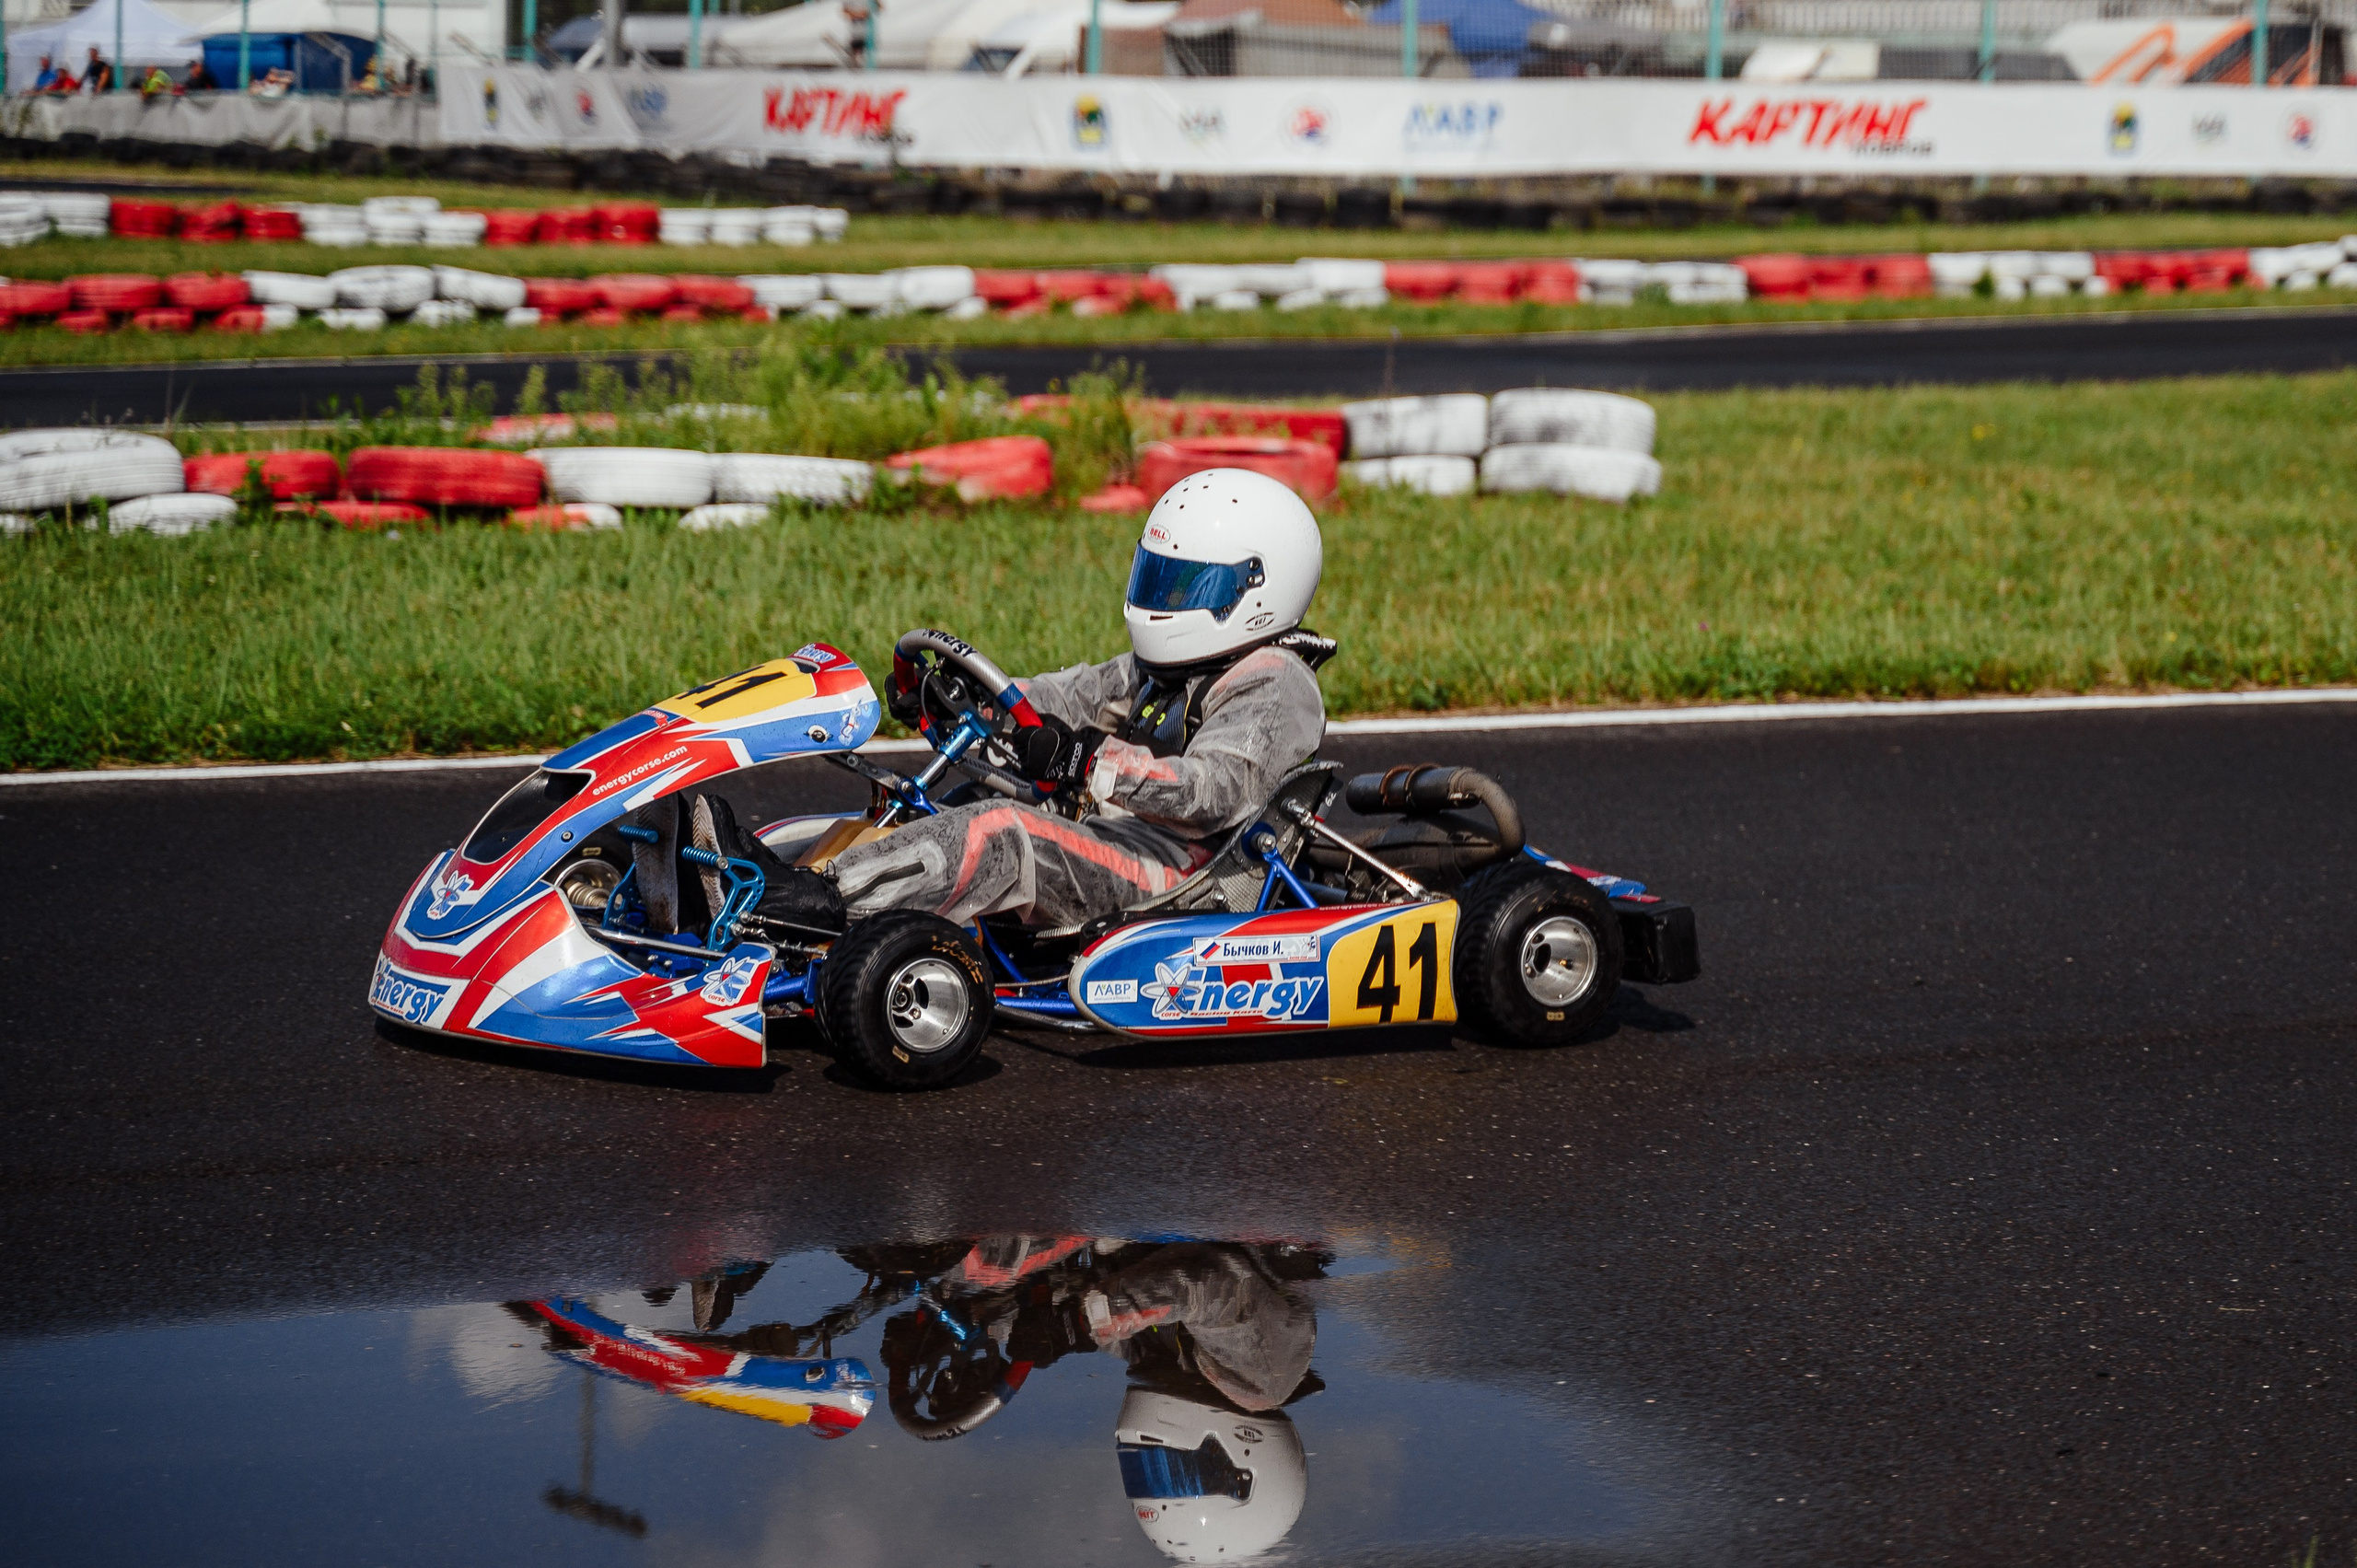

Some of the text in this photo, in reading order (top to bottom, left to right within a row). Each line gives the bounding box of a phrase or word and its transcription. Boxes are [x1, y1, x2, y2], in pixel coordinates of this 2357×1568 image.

[1689, 97, 1927, 147] КАРТИНГ
[592, 745, 689, 796] energycorse.com
[1223, 939, 1284, 958] Бычков И.
[1356, 921, 1438, 1024] 41
[707, 993, 726, 1003] corse
[1164, 966, 1324, 1017] Energy
